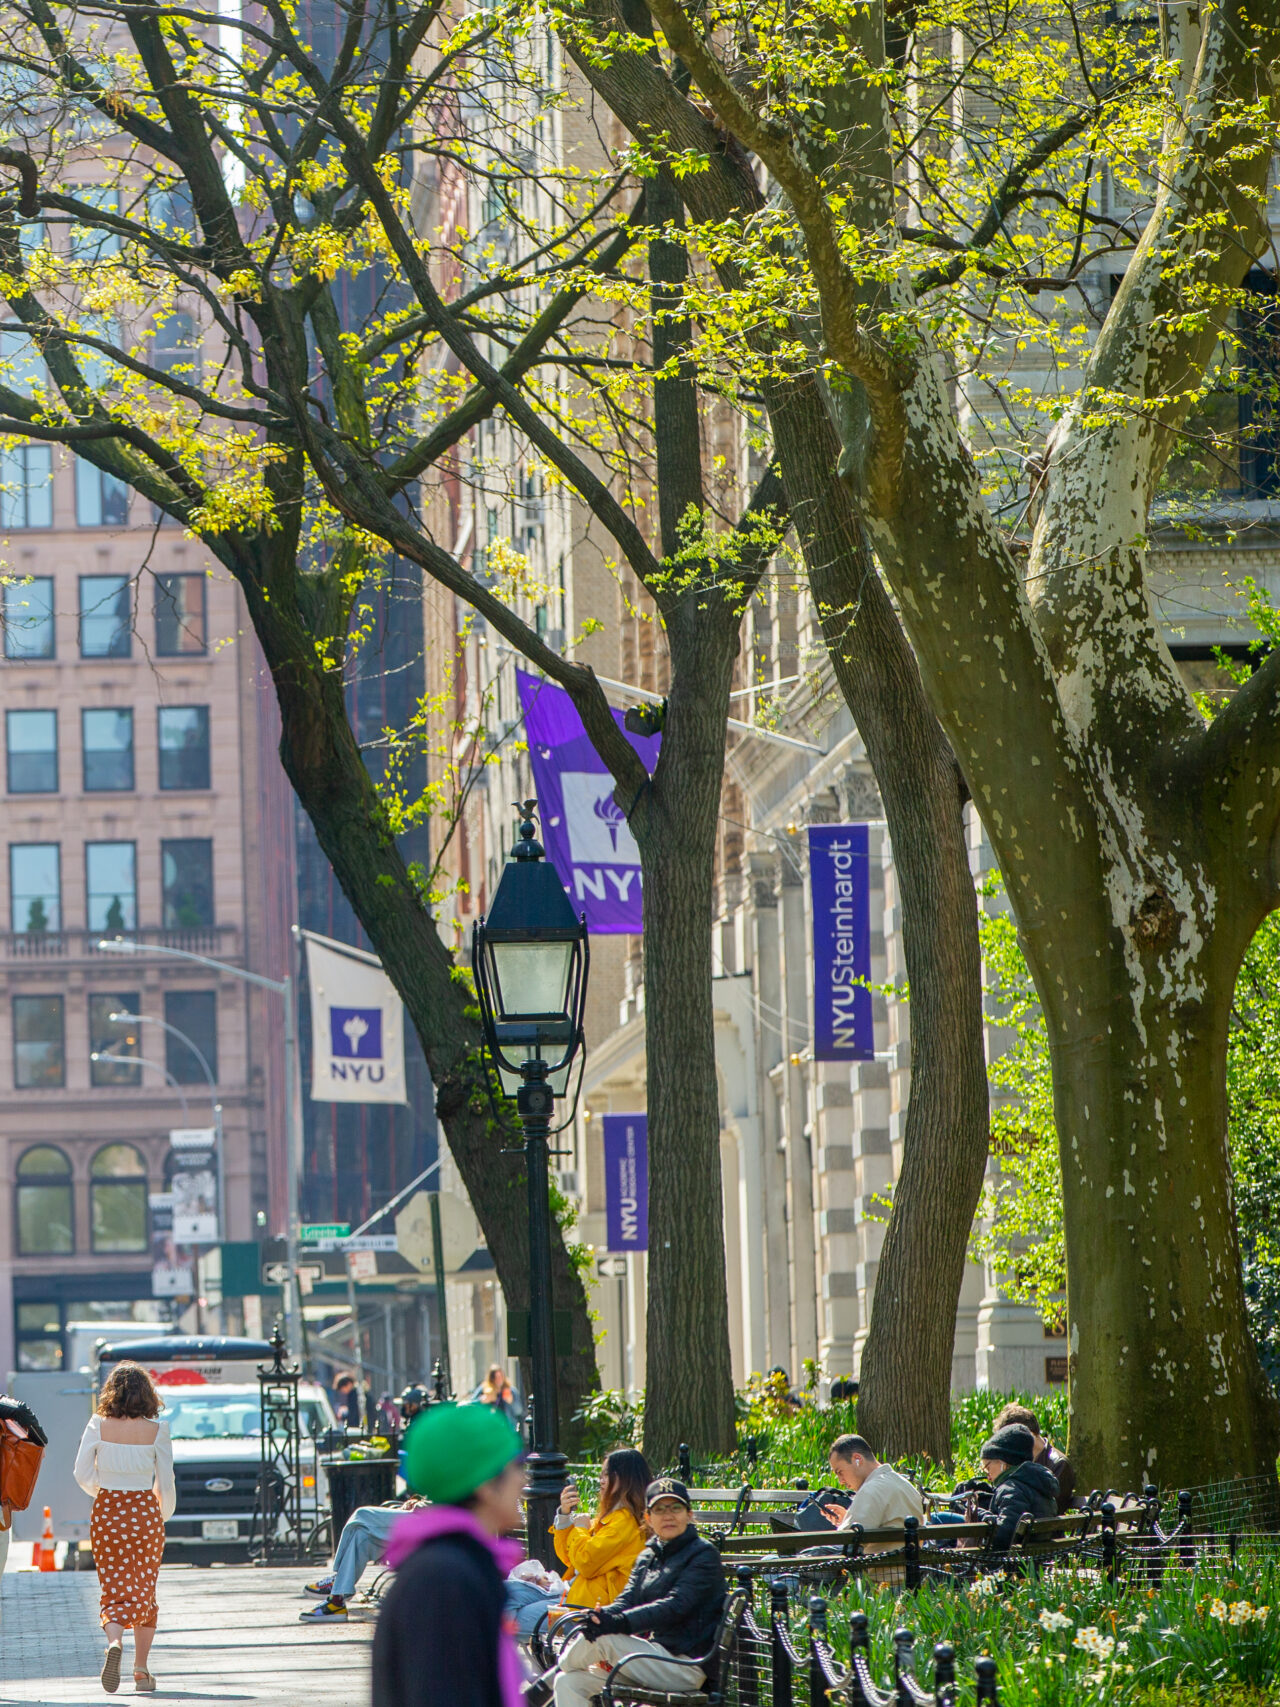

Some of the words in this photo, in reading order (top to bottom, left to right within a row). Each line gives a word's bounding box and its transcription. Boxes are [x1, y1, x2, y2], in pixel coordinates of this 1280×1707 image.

[573, 868, 643, 902] NY
[331, 1062, 385, 1083] NYU
[620, 1198, 638, 1241] NYU
